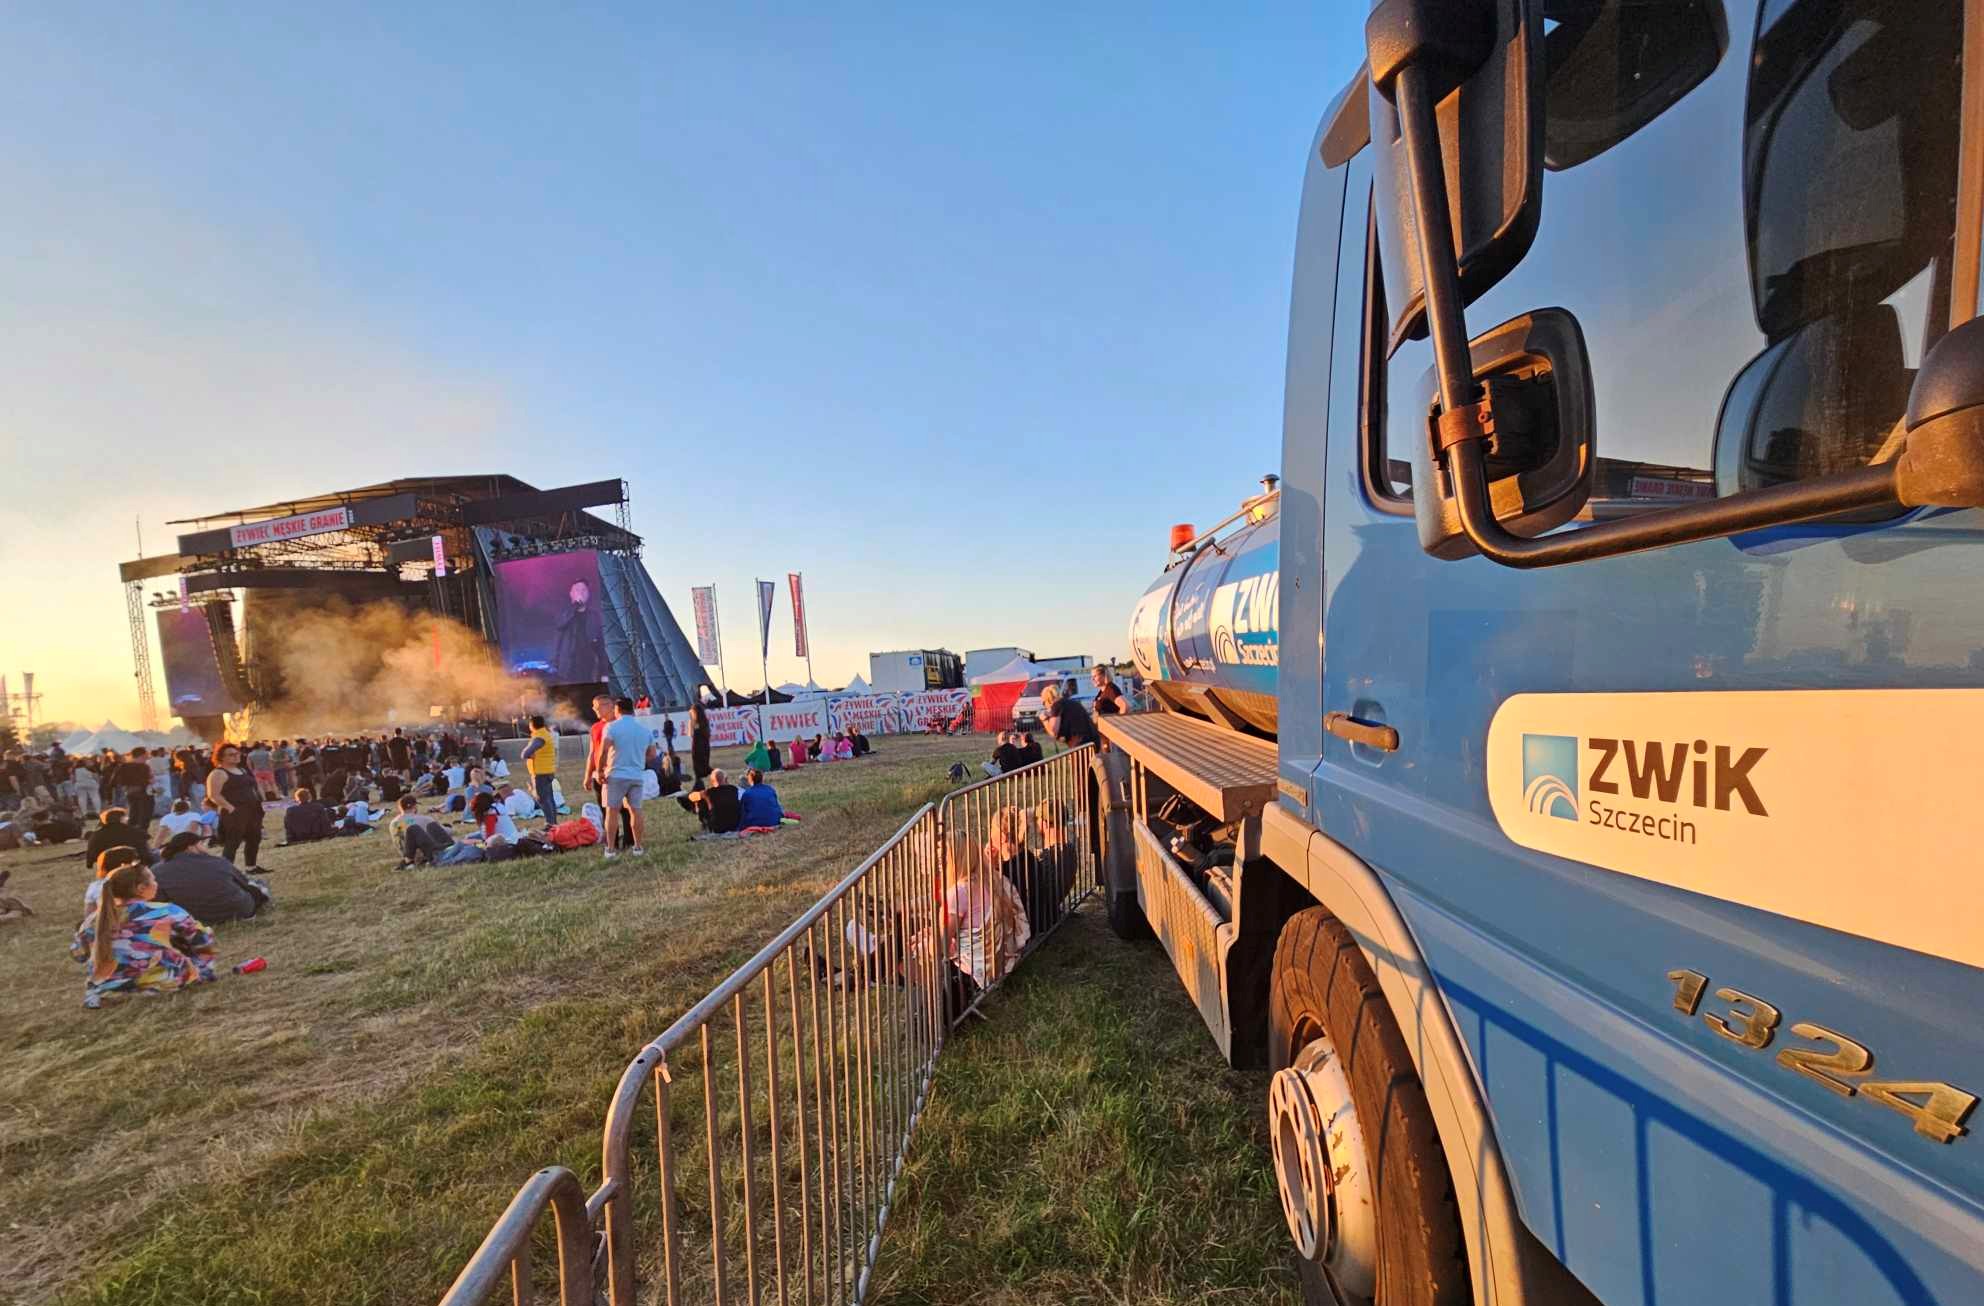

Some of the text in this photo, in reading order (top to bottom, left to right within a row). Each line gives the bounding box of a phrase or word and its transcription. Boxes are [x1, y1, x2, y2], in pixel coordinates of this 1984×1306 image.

[310, 511, 344, 529] GRANIE
[770, 711, 819, 731] ŻYWIEC
[1588, 738, 1769, 817] ZWiK
[1589, 800, 1696, 845] Szczecin
[1667, 969, 1980, 1144] 1324
